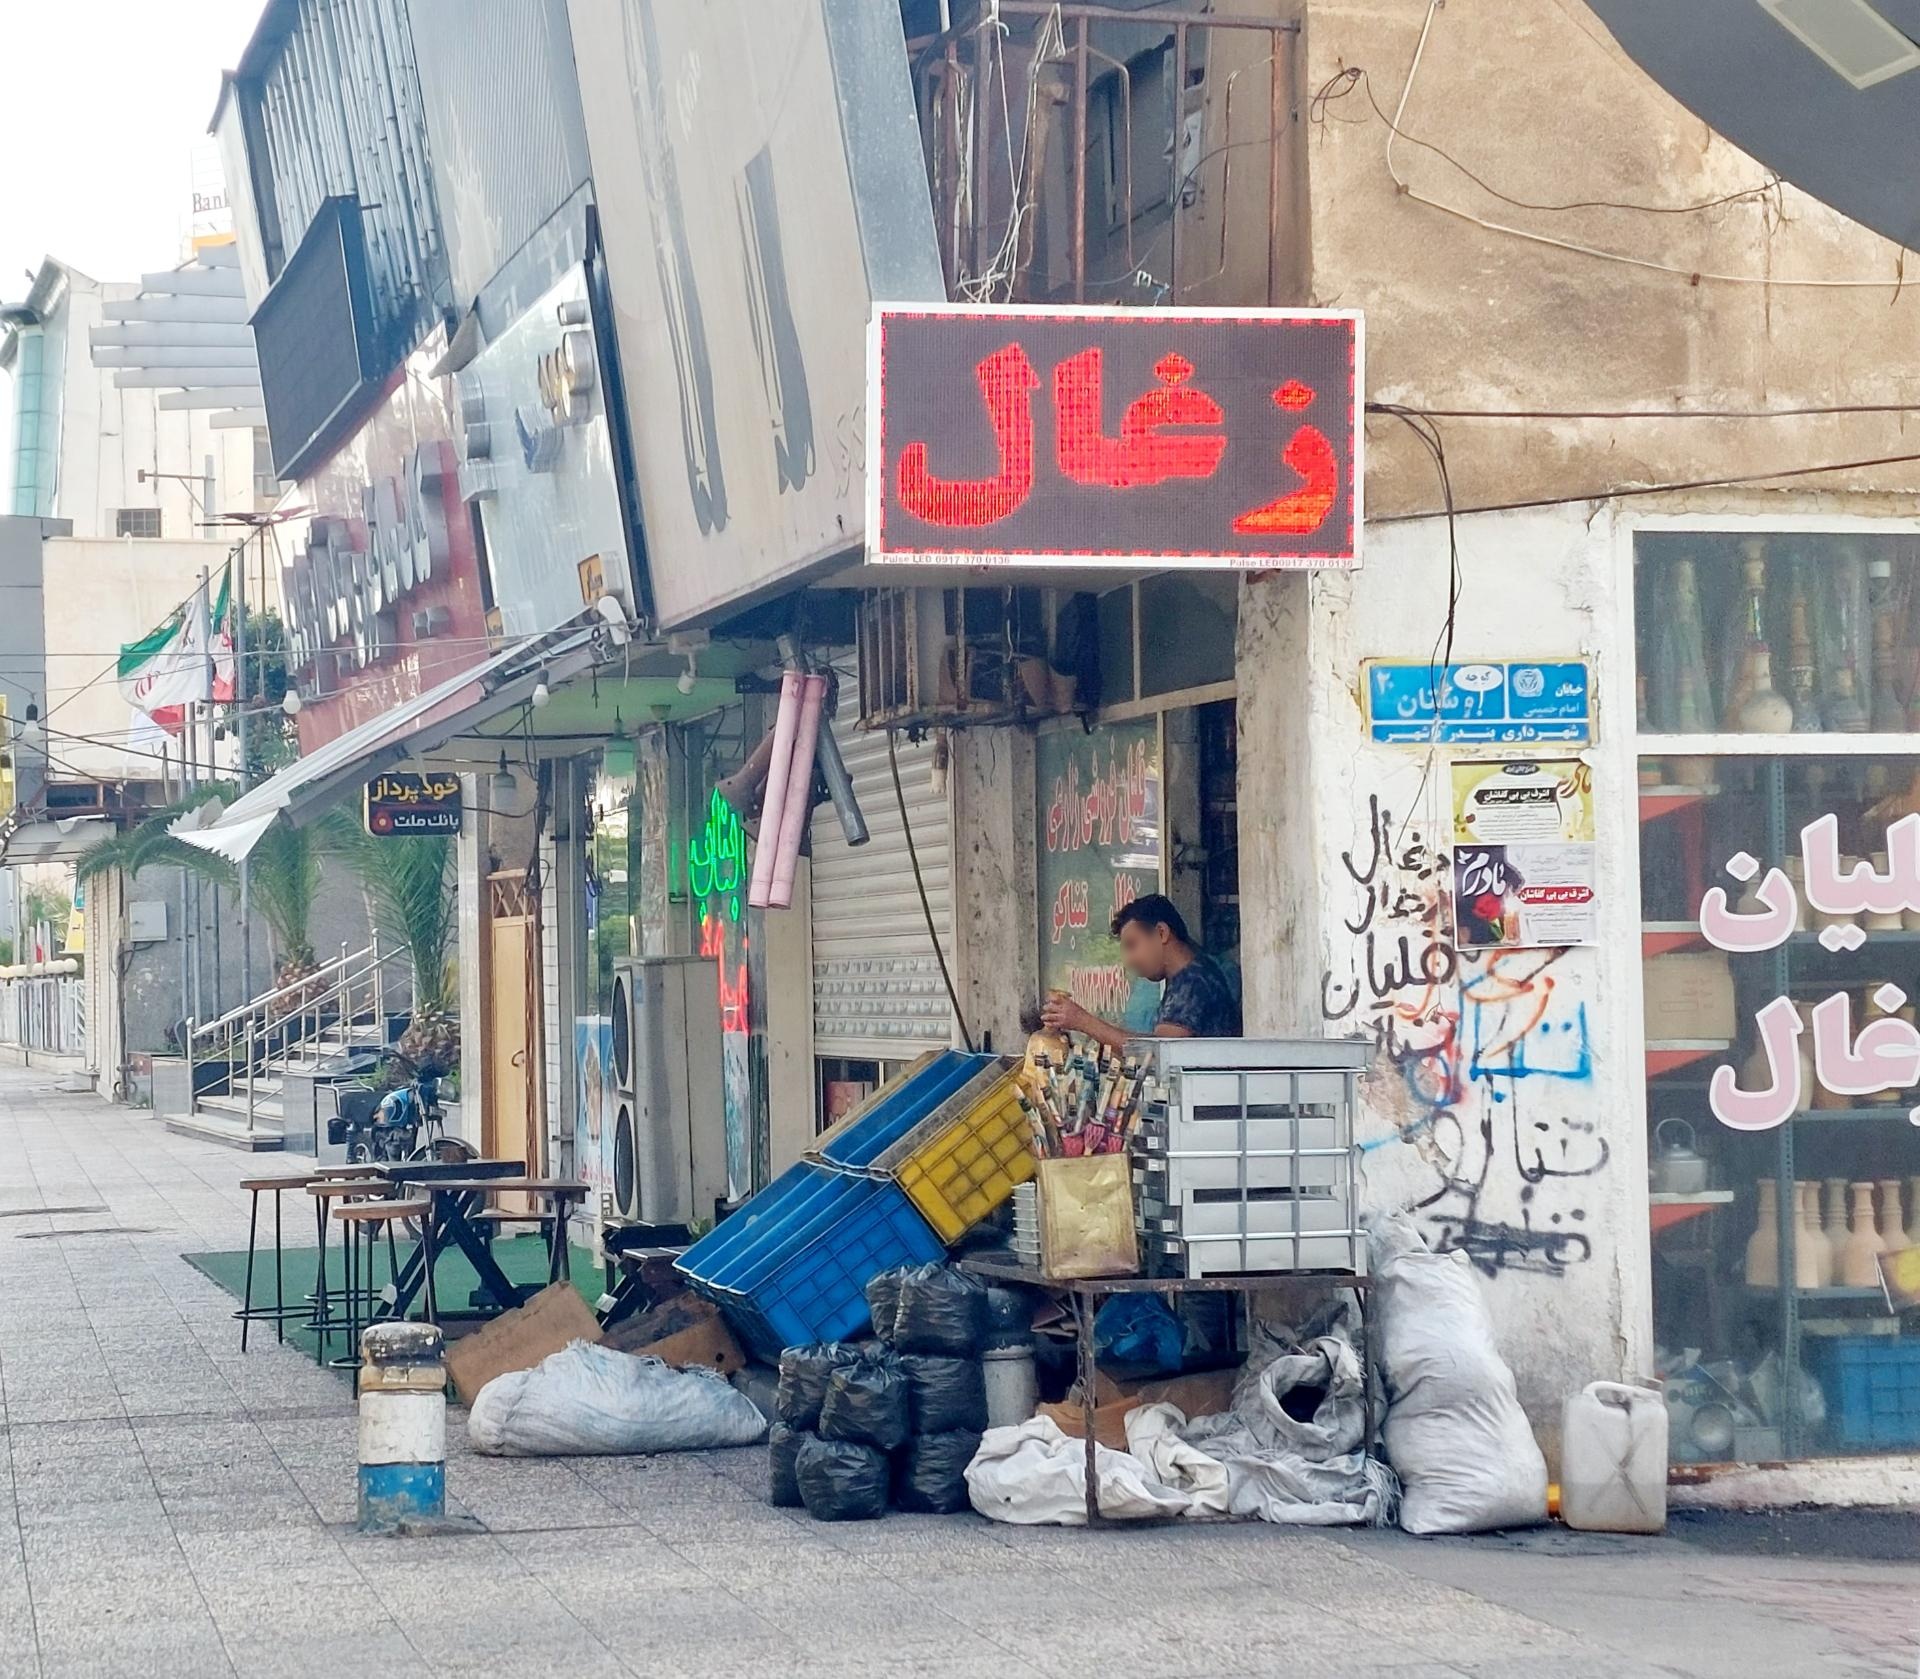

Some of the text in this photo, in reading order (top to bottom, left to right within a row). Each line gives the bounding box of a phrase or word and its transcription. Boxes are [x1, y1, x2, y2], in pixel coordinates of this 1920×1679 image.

[897, 341, 1338, 535] زغال
[913, 554, 932, 564] LED
[1555, 683, 1584, 698] خیابان
[1559, 702, 1580, 716] امام
[1449, 726, 1495, 742] بندر
[1502, 724, 1579, 742] شهرداری
[371, 777, 459, 803] خود پرداز
[1081, 734, 1117, 844] فروشی
[394, 814, 459, 830] بانک ملت
[1462, 852, 1507, 897] مادرم
[1700, 813, 1920, 952] لیان
[1052, 880, 1088, 950] تنباکو
[1322, 926, 1457, 1020] قلیان
[1710, 982, 1920, 1131] غال
